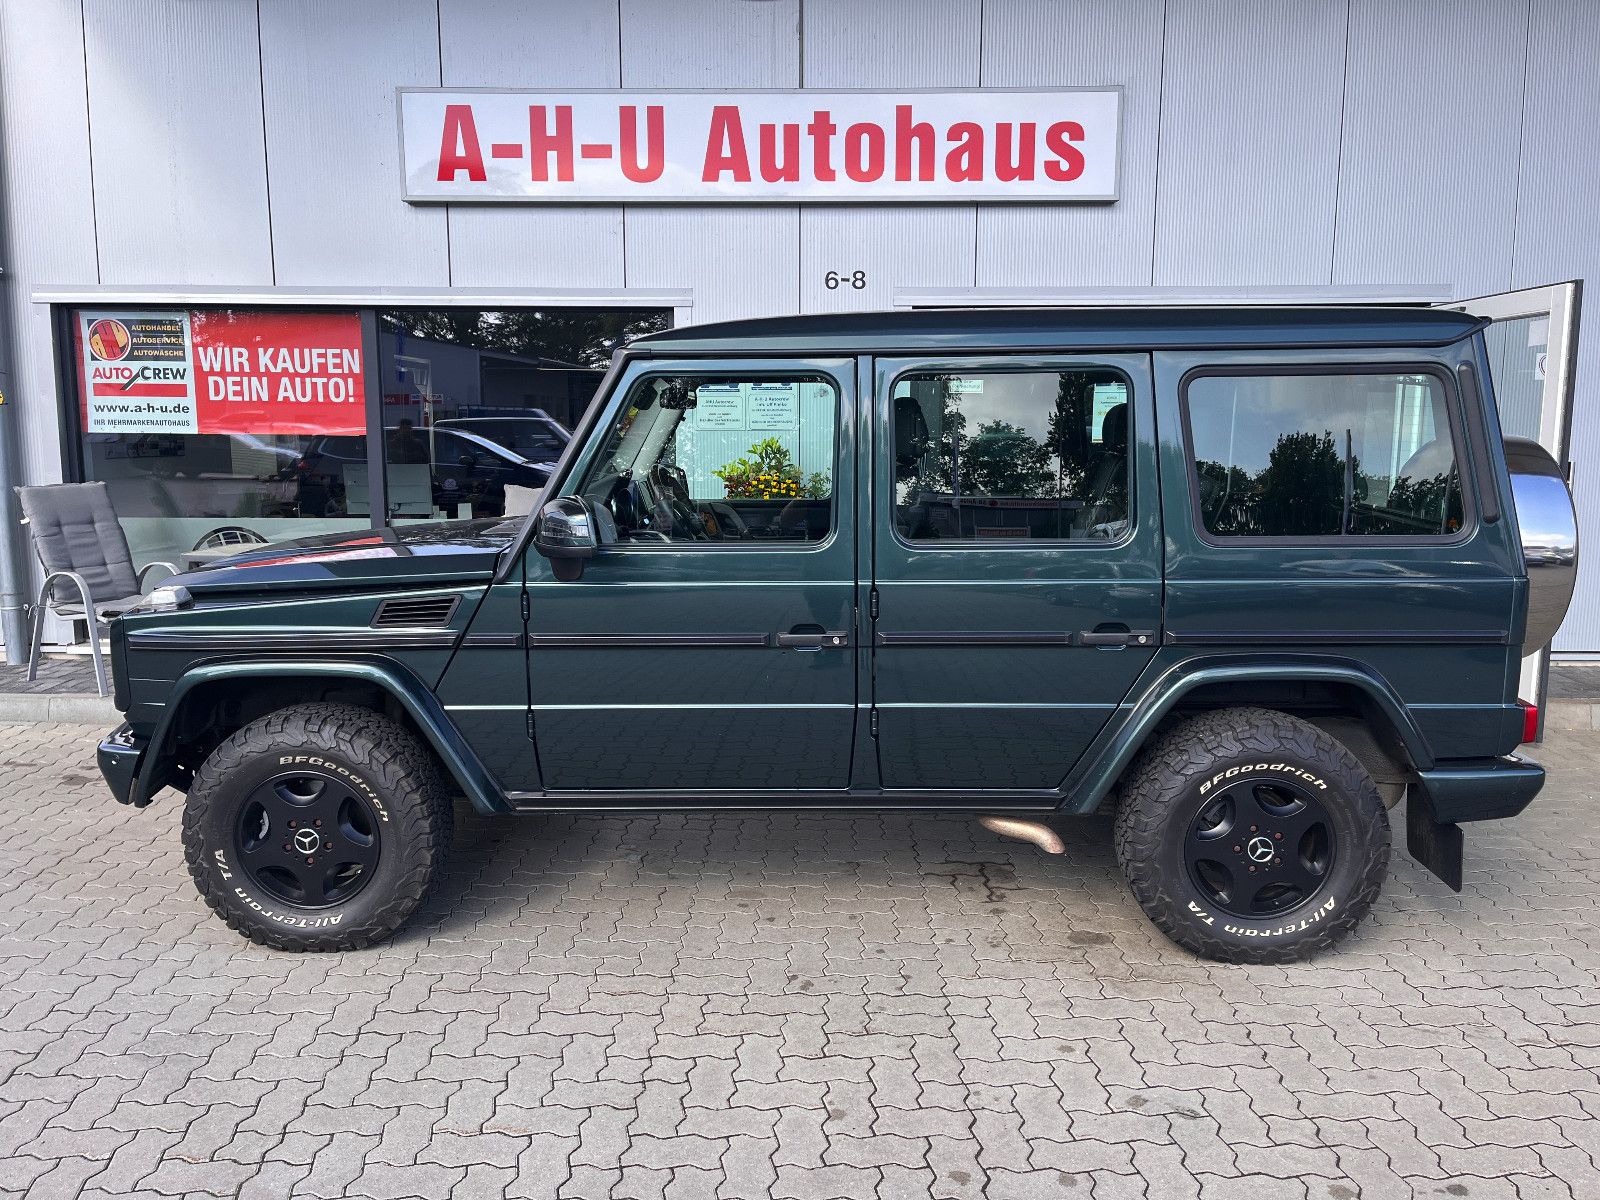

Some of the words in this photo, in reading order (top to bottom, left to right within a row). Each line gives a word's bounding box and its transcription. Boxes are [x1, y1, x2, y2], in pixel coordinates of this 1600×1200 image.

[437, 104, 665, 183] A-H-U
[701, 104, 1086, 183] Autohaus
[824, 270, 867, 290] 6-8
[197, 347, 250, 373] WIR
[258, 347, 361, 374] KAUFEN
[207, 376, 269, 402] DEIN
[276, 377, 355, 403] AUTO!
[94, 403, 190, 414] www.a-h-u.de
[107, 419, 191, 427] MEHRMARKENAUTOHAUS
[278, 755, 390, 823] BFGoodrich
[1199, 762, 1329, 796] BFGoodrich
[214, 848, 233, 881] T/A
[234, 887, 344, 929] All-Terrain
[1187, 899, 1216, 927] T/A
[1224, 895, 1337, 938] All-Terrain
